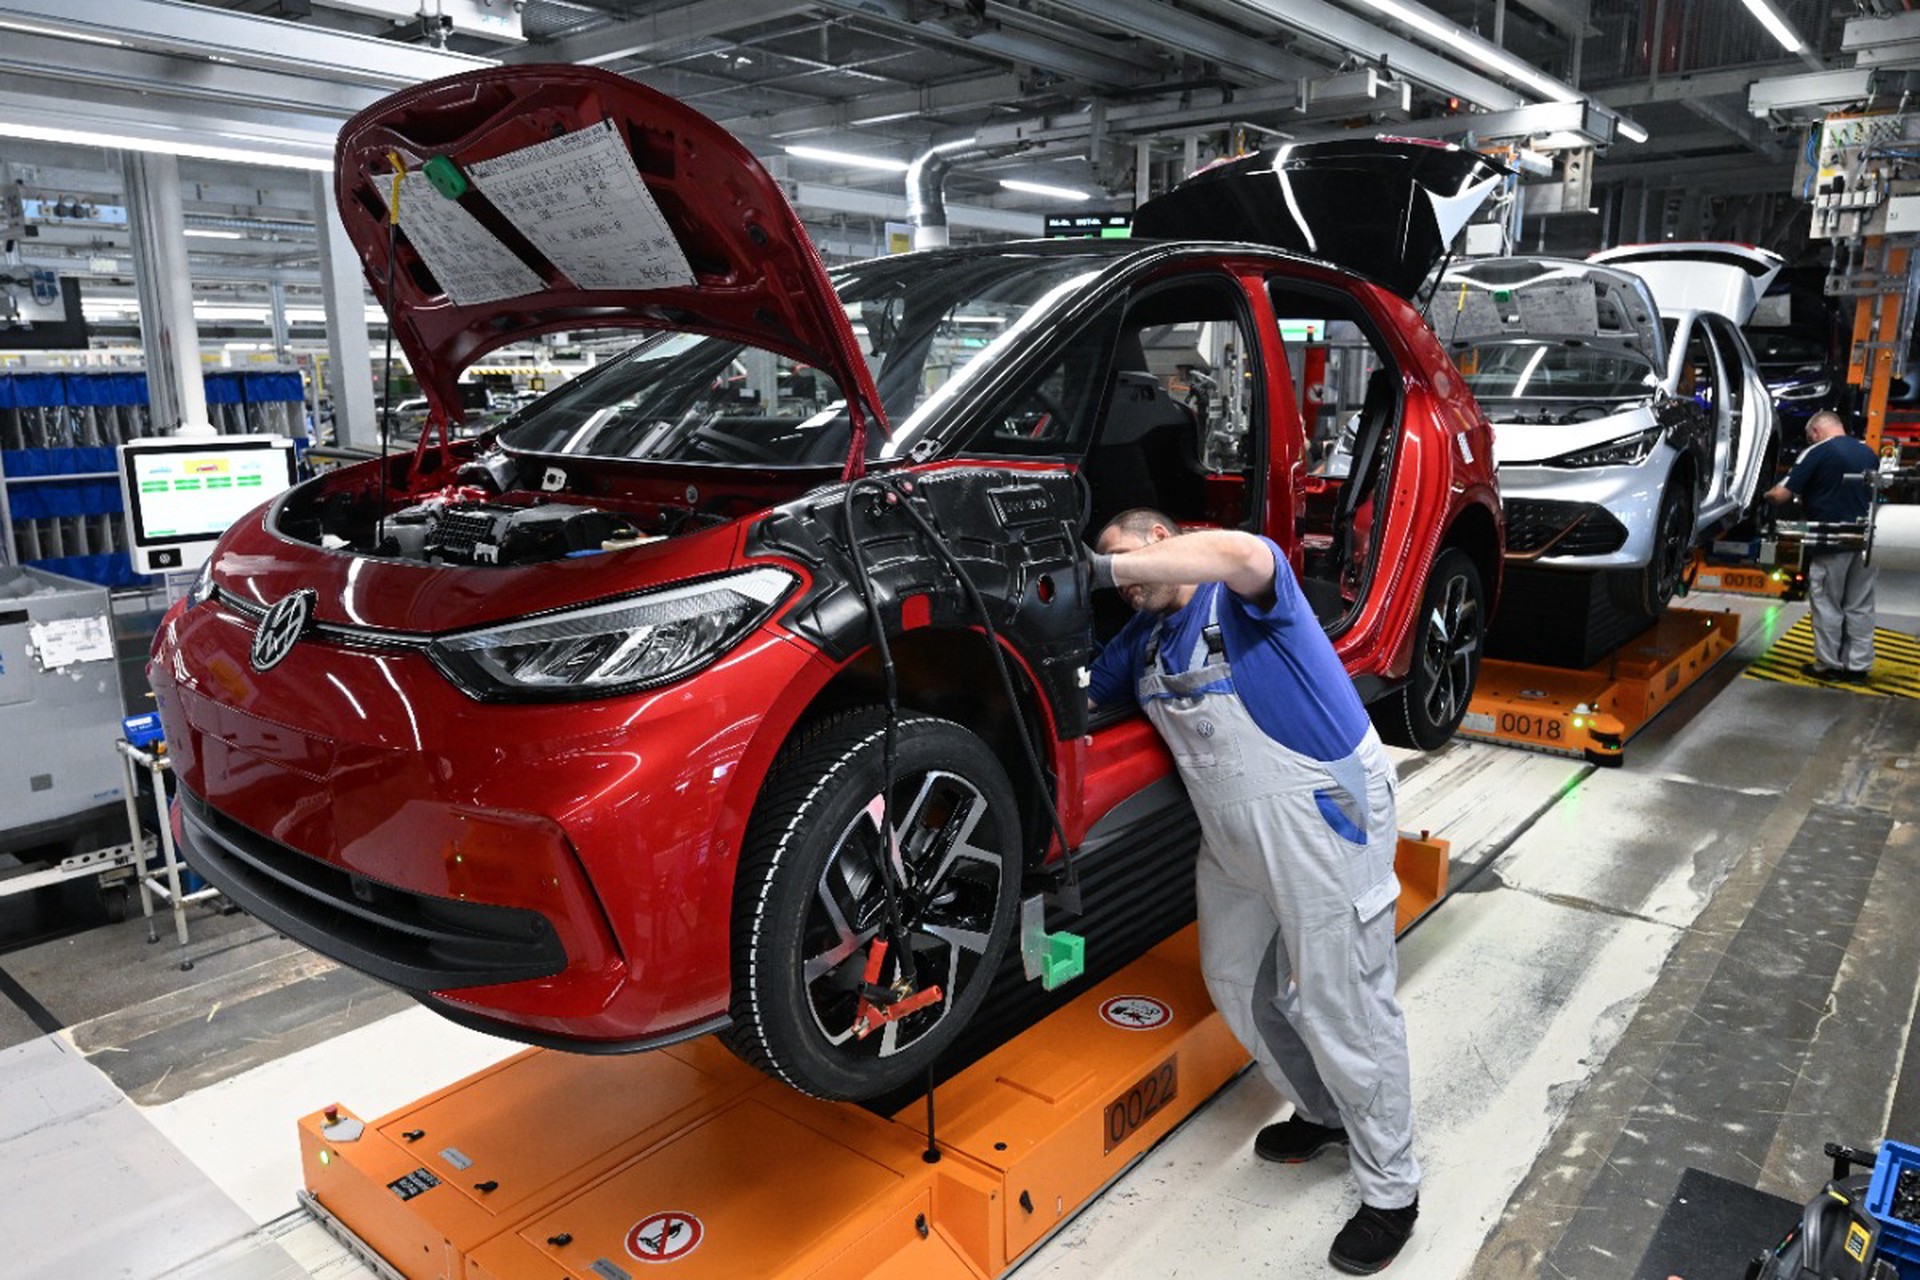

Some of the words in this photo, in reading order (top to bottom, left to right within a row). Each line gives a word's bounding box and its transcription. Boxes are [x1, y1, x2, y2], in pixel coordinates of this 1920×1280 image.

[1724, 572, 1764, 588] 0013
[1502, 713, 1561, 739] 0018
[1111, 1063, 1174, 1142] 0022
